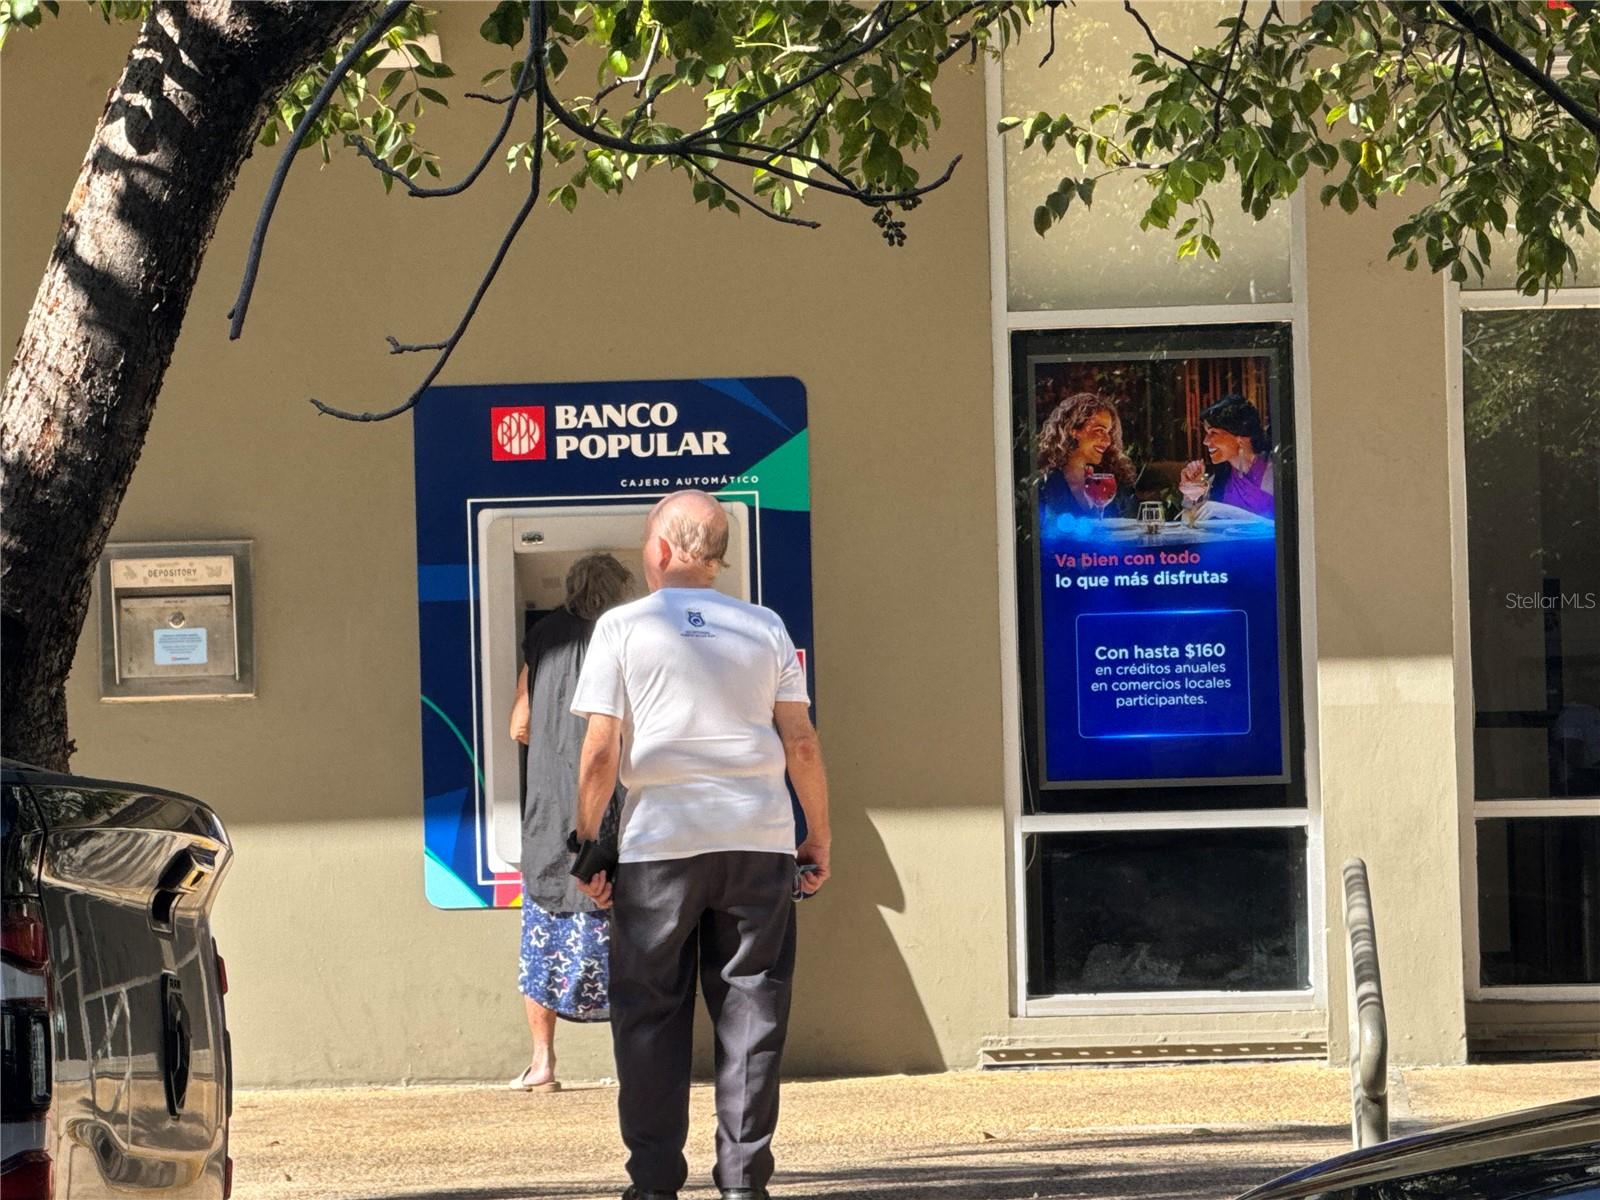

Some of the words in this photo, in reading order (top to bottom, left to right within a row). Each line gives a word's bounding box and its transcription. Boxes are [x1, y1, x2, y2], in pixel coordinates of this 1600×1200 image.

[555, 403, 677, 429] BANCO
[556, 432, 730, 459] POPULAR
[621, 479, 670, 488] CAJERO
[676, 475, 759, 485] AUTOMÁTICO
[1055, 554, 1075, 568] Va
[1082, 553, 1118, 567] bien
[1124, 554, 1155, 565] con
[1160, 550, 1200, 564] todo
[148, 569, 197, 577] DEPOSITORY
[1056, 574, 1071, 588] lo
[1077, 574, 1109, 589] que
[1115, 572, 1148, 586] más
[1154, 571, 1228, 584] disfrutas
[1095, 647, 1128, 660] Con
[1134, 645, 1179, 658] hasta
[1185, 643, 1225, 659] $160
[1095, 665, 1111, 675] en
[1116, 663, 1171, 674] créditos
[1175, 662, 1226, 673] anuales
[1091, 683, 1107, 691] en
[1112, 679, 1181, 690] comercios
[1185, 678, 1231, 688] locales
[1116, 694, 1207, 708] participantes.
